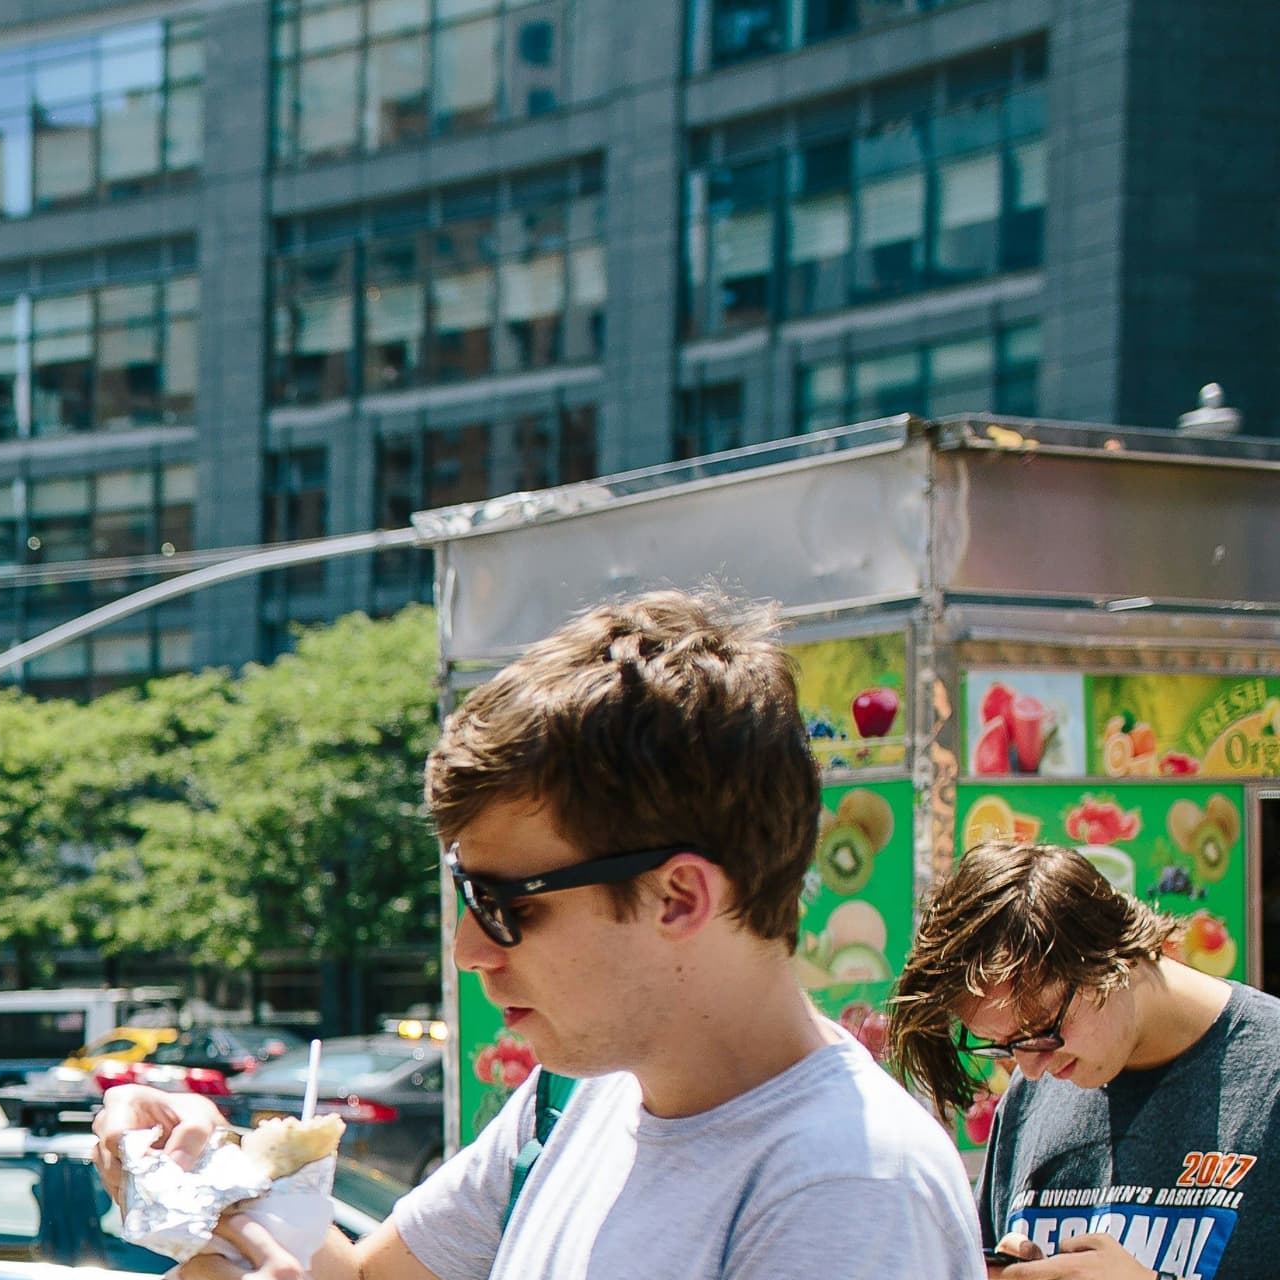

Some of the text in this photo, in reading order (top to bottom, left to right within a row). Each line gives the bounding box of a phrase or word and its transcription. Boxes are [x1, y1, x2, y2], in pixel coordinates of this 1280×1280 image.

[1176, 1151, 1257, 1188] 2017
[1040, 1187, 1099, 1207] DIVISION
[1154, 1187, 1244, 1209] BASKETBALL
